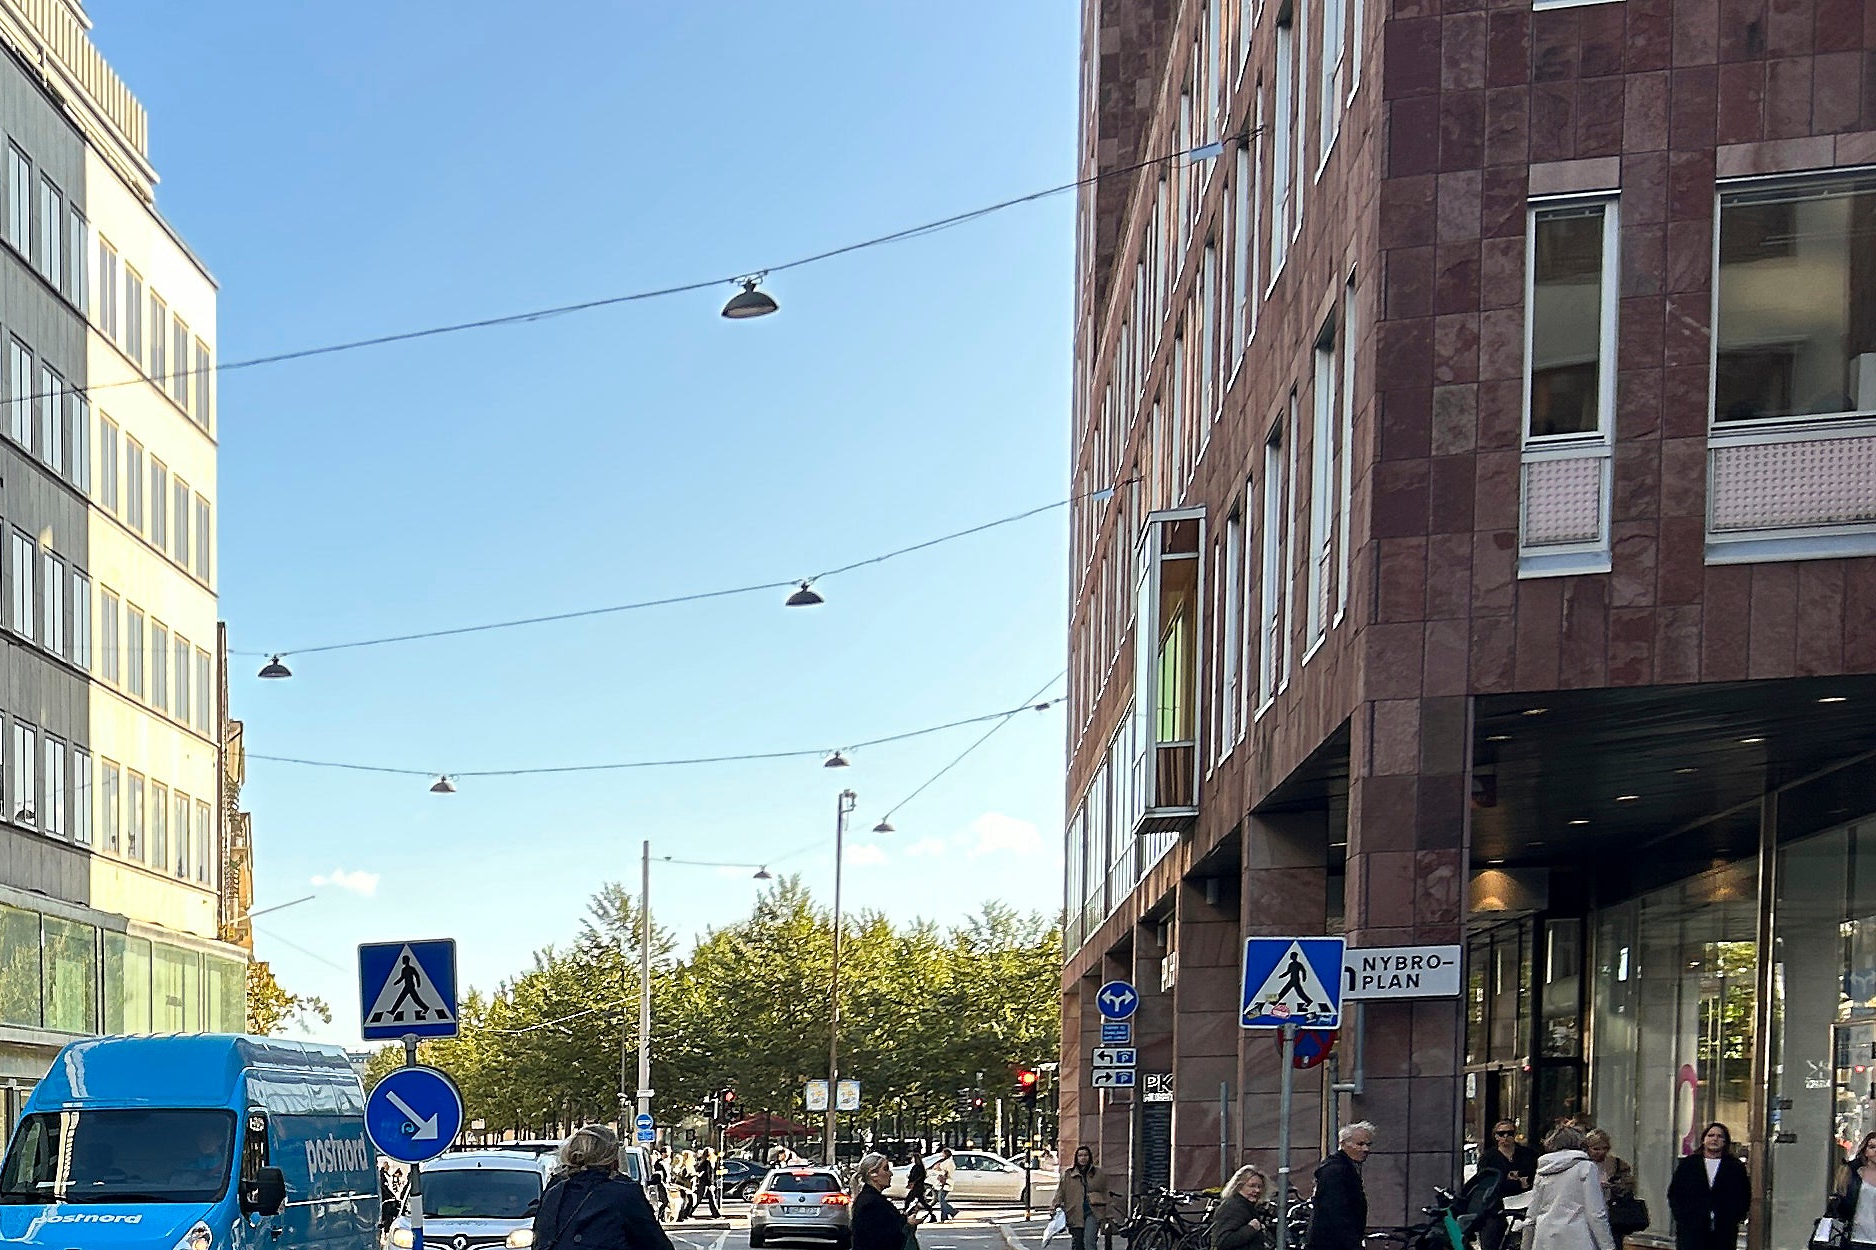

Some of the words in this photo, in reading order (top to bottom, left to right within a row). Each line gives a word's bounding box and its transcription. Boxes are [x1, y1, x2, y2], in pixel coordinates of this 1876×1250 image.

[1362, 954, 1454, 972] NYBRO-
[1362, 973, 1420, 990] PLAN
[305, 1132, 368, 1183] postnord
